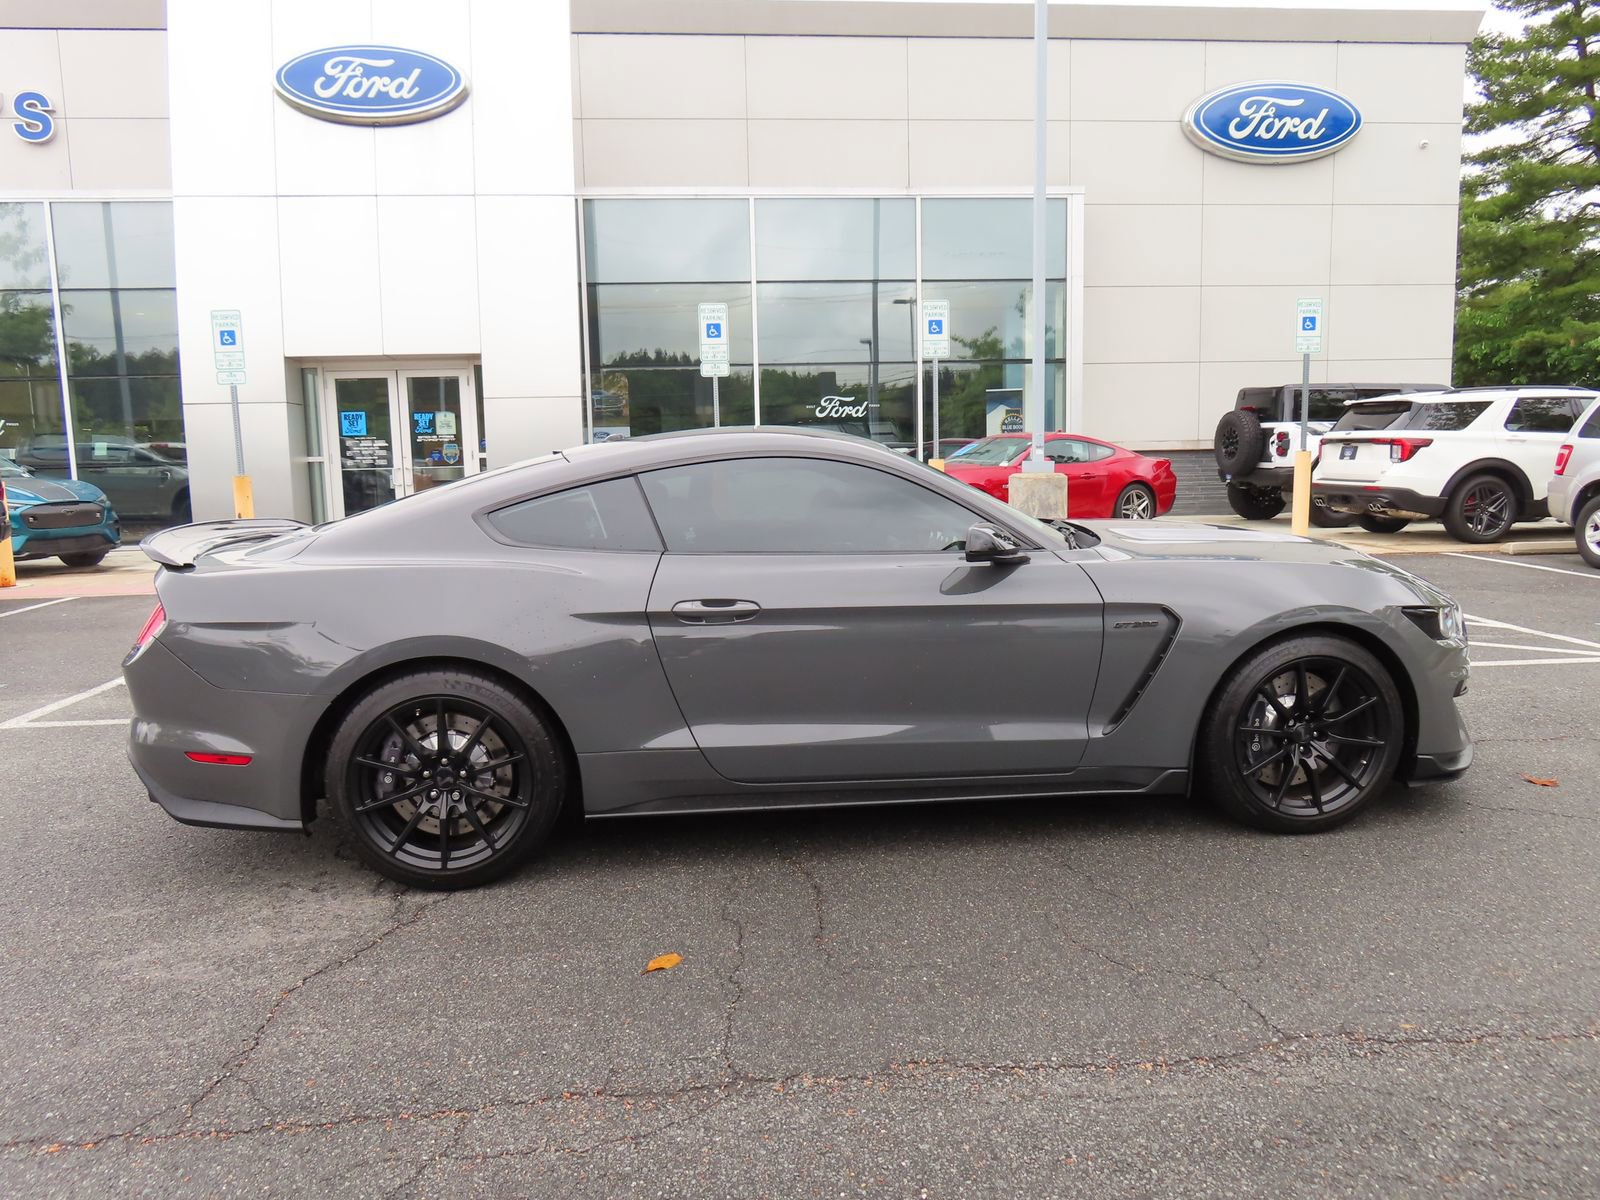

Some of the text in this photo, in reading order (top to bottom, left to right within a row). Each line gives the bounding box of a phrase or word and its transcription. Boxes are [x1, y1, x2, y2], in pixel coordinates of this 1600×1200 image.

[314, 56, 422, 99] Ford
[1228, 96, 1329, 139] Ford
[815, 395, 869, 418] Ford
[1004, 416, 1022, 424] KELLEY
